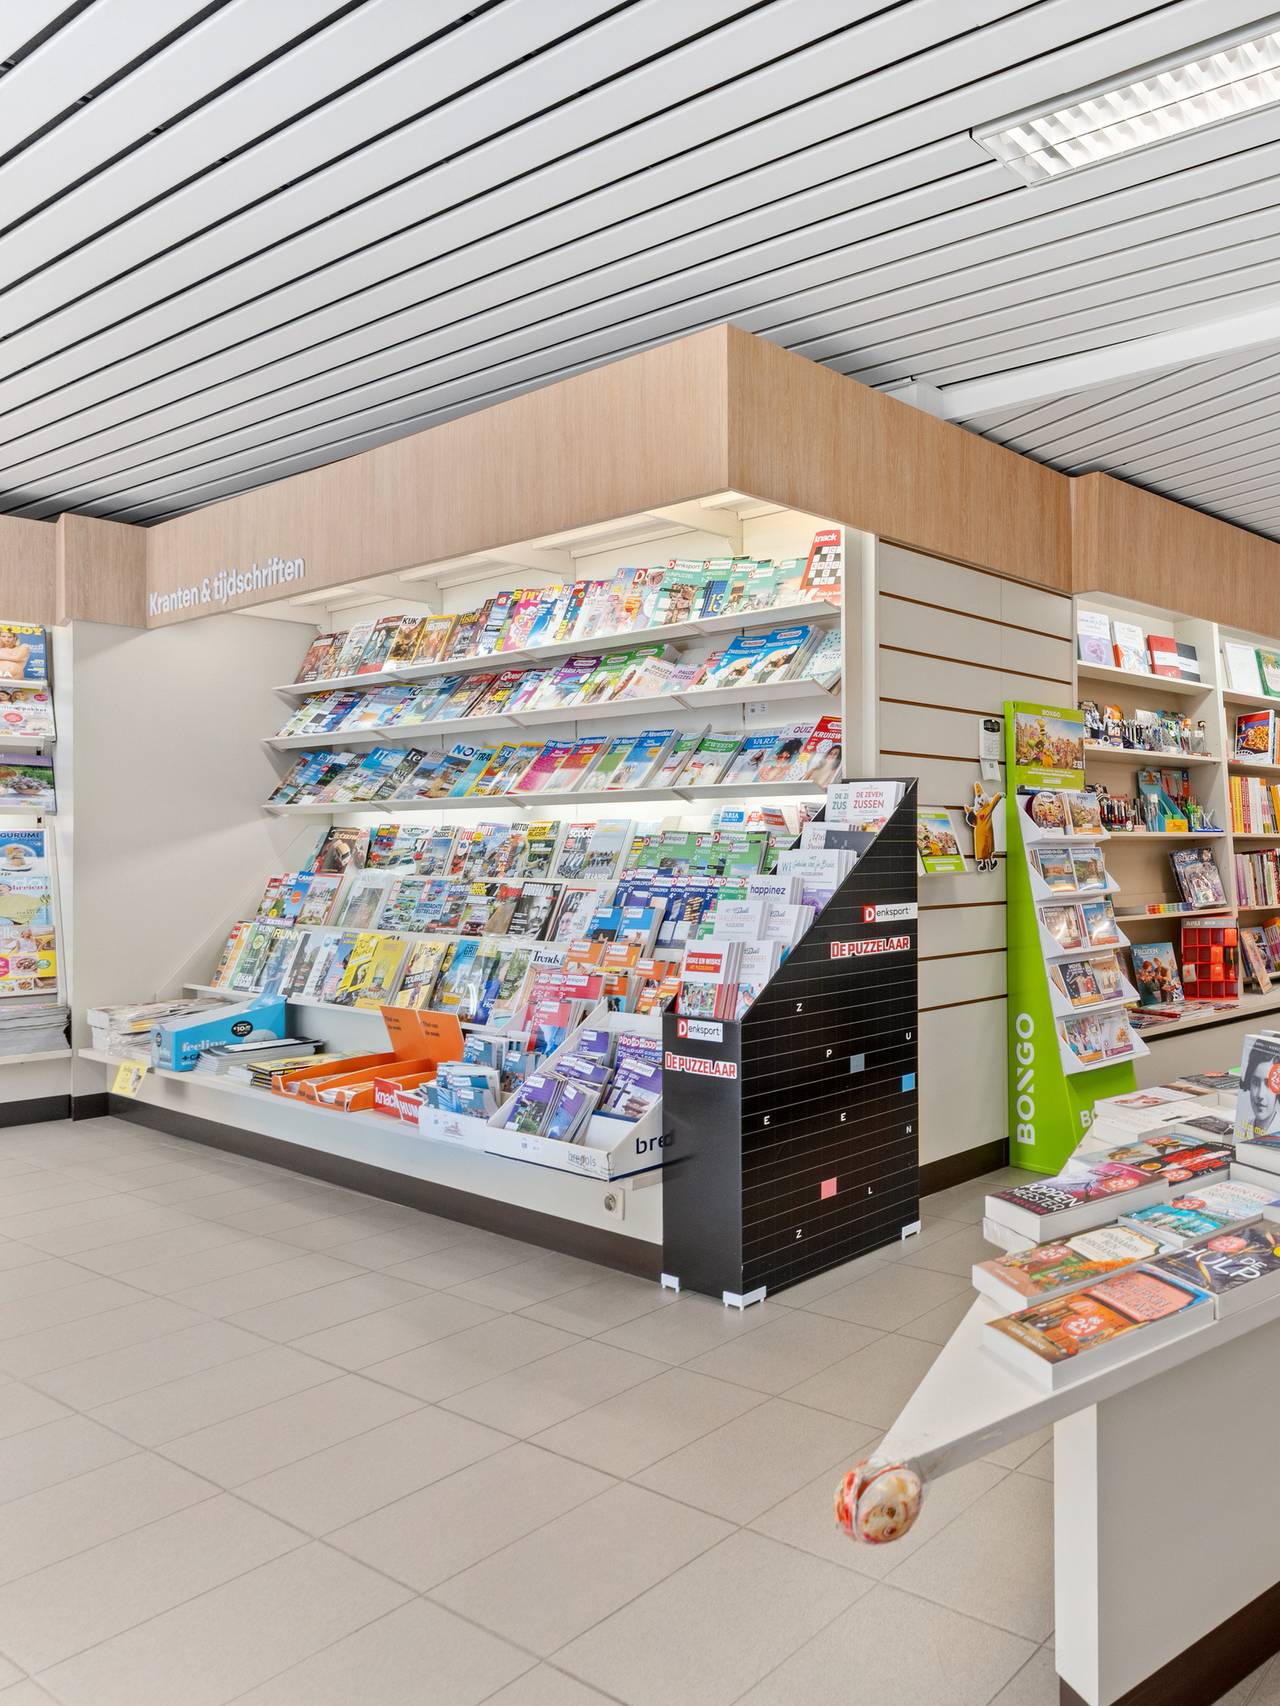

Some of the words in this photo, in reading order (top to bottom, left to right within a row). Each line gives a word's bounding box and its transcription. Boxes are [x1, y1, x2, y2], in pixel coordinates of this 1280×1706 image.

[150, 586, 199, 616] Kranten
[201, 578, 211, 602] &
[213, 556, 304, 604] tijdschriften
[854, 799, 885, 809] ZUSSEN
[750, 885, 786, 896] happinez
[864, 906, 911, 923] Denksport
[831, 941, 846, 958] DE
[848, 936, 909, 956] PUZZELAAR
[533, 950, 560, 964] Trends
[796, 1003, 802, 1012] Z
[678, 1019, 721, 1038] Denksport
[906, 1032, 911, 1040] U
[827, 1049, 832, 1058] P
[665, 1052, 677, 1070] DE
[678, 1055, 737, 1078] PUZZELAAR
[1016, 1013, 1035, 1145] BONGO
[764, 1116, 770, 1125] E
[841, 1113, 847, 1121] E
[906, 1125, 912, 1134] N
[868, 1186, 873, 1195] L
[796, 1229, 802, 1239] Z
[1183, 1247, 1261, 1279] HULP
[1240, 1257, 1267, 1270] DE
